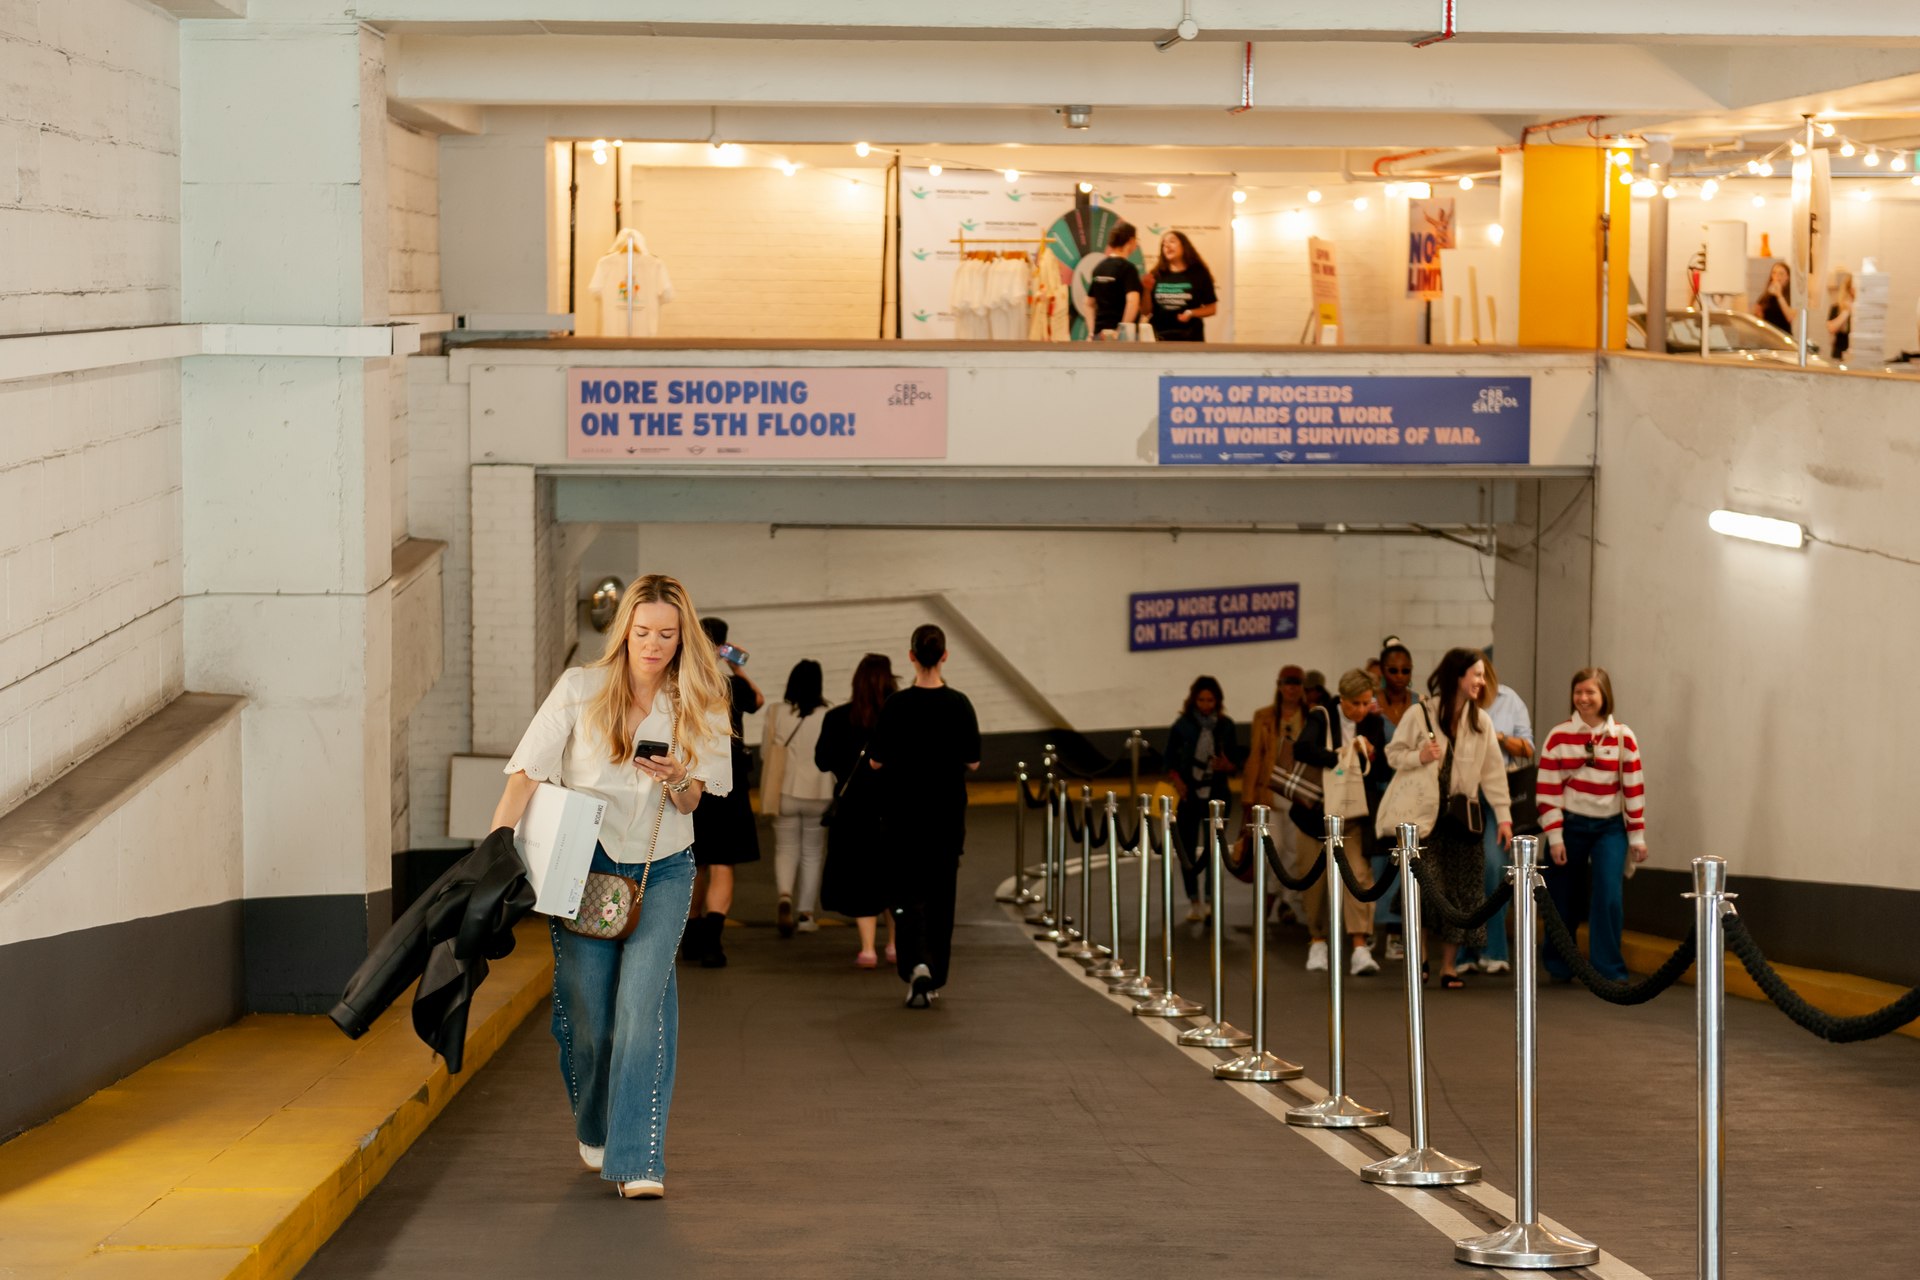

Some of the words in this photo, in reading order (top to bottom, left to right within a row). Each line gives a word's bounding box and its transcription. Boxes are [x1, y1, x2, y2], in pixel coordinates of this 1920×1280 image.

[1410, 232, 1436, 263] NO
[581, 380, 658, 404] MORE
[667, 380, 808, 404] SHOPPING
[1170, 385, 1223, 403] 100%
[1227, 385, 1253, 403] OF
[1257, 385, 1353, 404] PROCEEDS
[581, 412, 619, 436] ON
[629, 412, 683, 436] THE
[693, 412, 748, 436] 5TH
[758, 412, 856, 436] FLOOR!
[1170, 406, 1198, 424] GO
[1201, 406, 1290, 424] TOWARDS
[1295, 406, 1333, 424] OUR
[1338, 406, 1393, 424] WORK
[1170, 427, 1219, 445] WITH
[1223, 427, 1292, 445] WOMEN
[1296, 427, 1400, 445] SURVIVORS
[1404, 427, 1430, 445] OF
[1434, 427, 1481, 445] WAR.
[1135, 599, 1174, 619] SHOP
[1177, 596, 1216, 616] MORE
[1219, 593, 1248, 613] CAR
[1251, 590, 1295, 612] BOOTS
[1134, 623, 1156, 643] ON
[1160, 622, 1188, 641] THE
[1191, 619, 1219, 639] 6TH
[1222, 616, 1271, 637] FLOOR!
